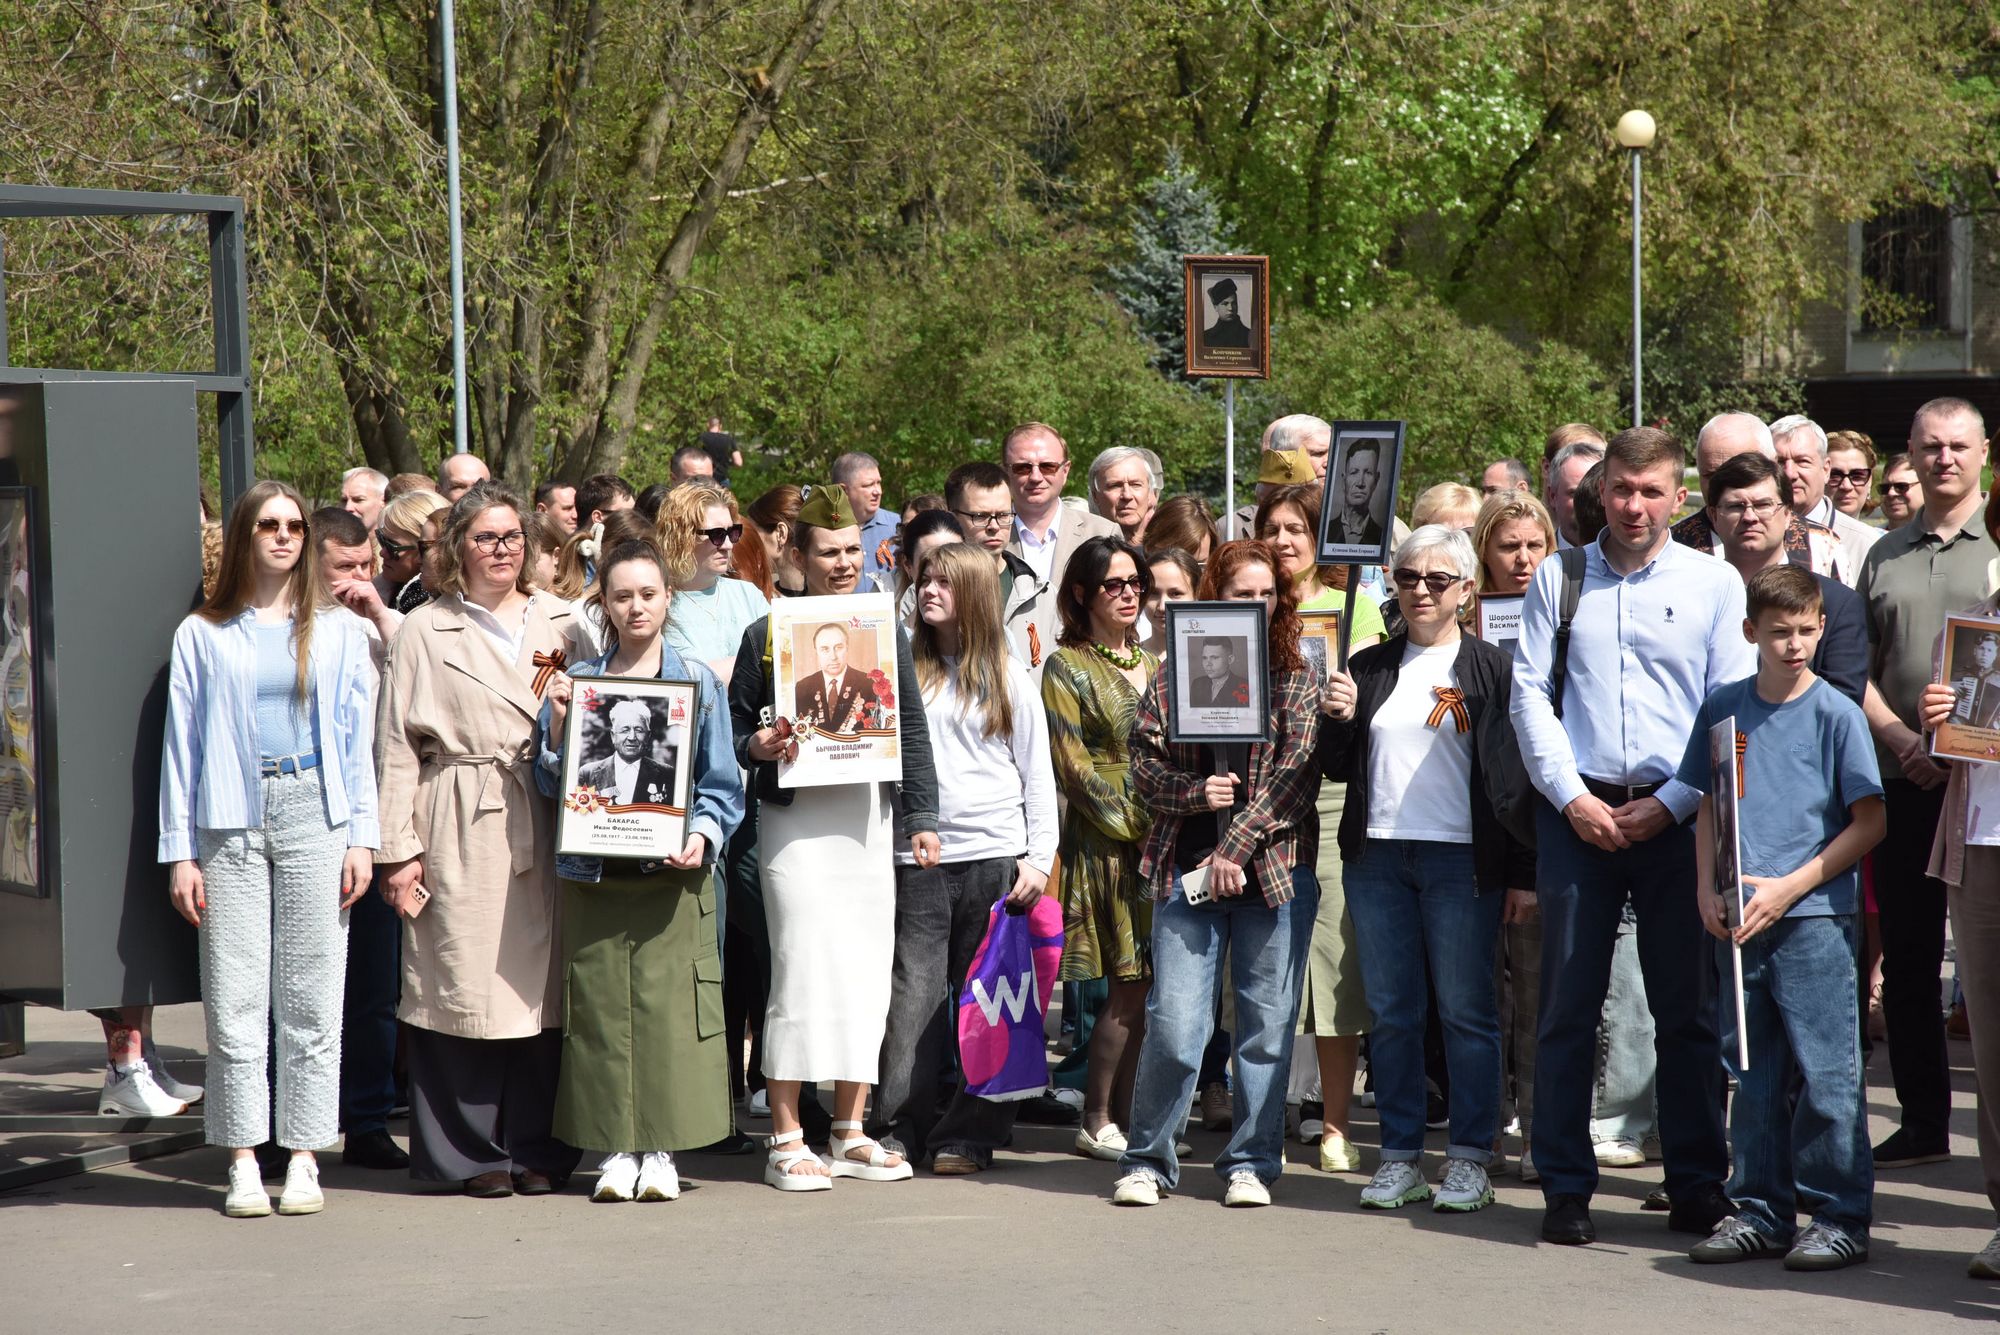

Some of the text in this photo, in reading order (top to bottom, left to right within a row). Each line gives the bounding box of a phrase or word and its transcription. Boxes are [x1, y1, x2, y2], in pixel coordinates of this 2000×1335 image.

[816, 743, 873, 753] БЫЧКОВ ВЛАДИМИР
[607, 817, 640, 825] БАКАРАС
[611, 825, 653, 833] Федосеевич
